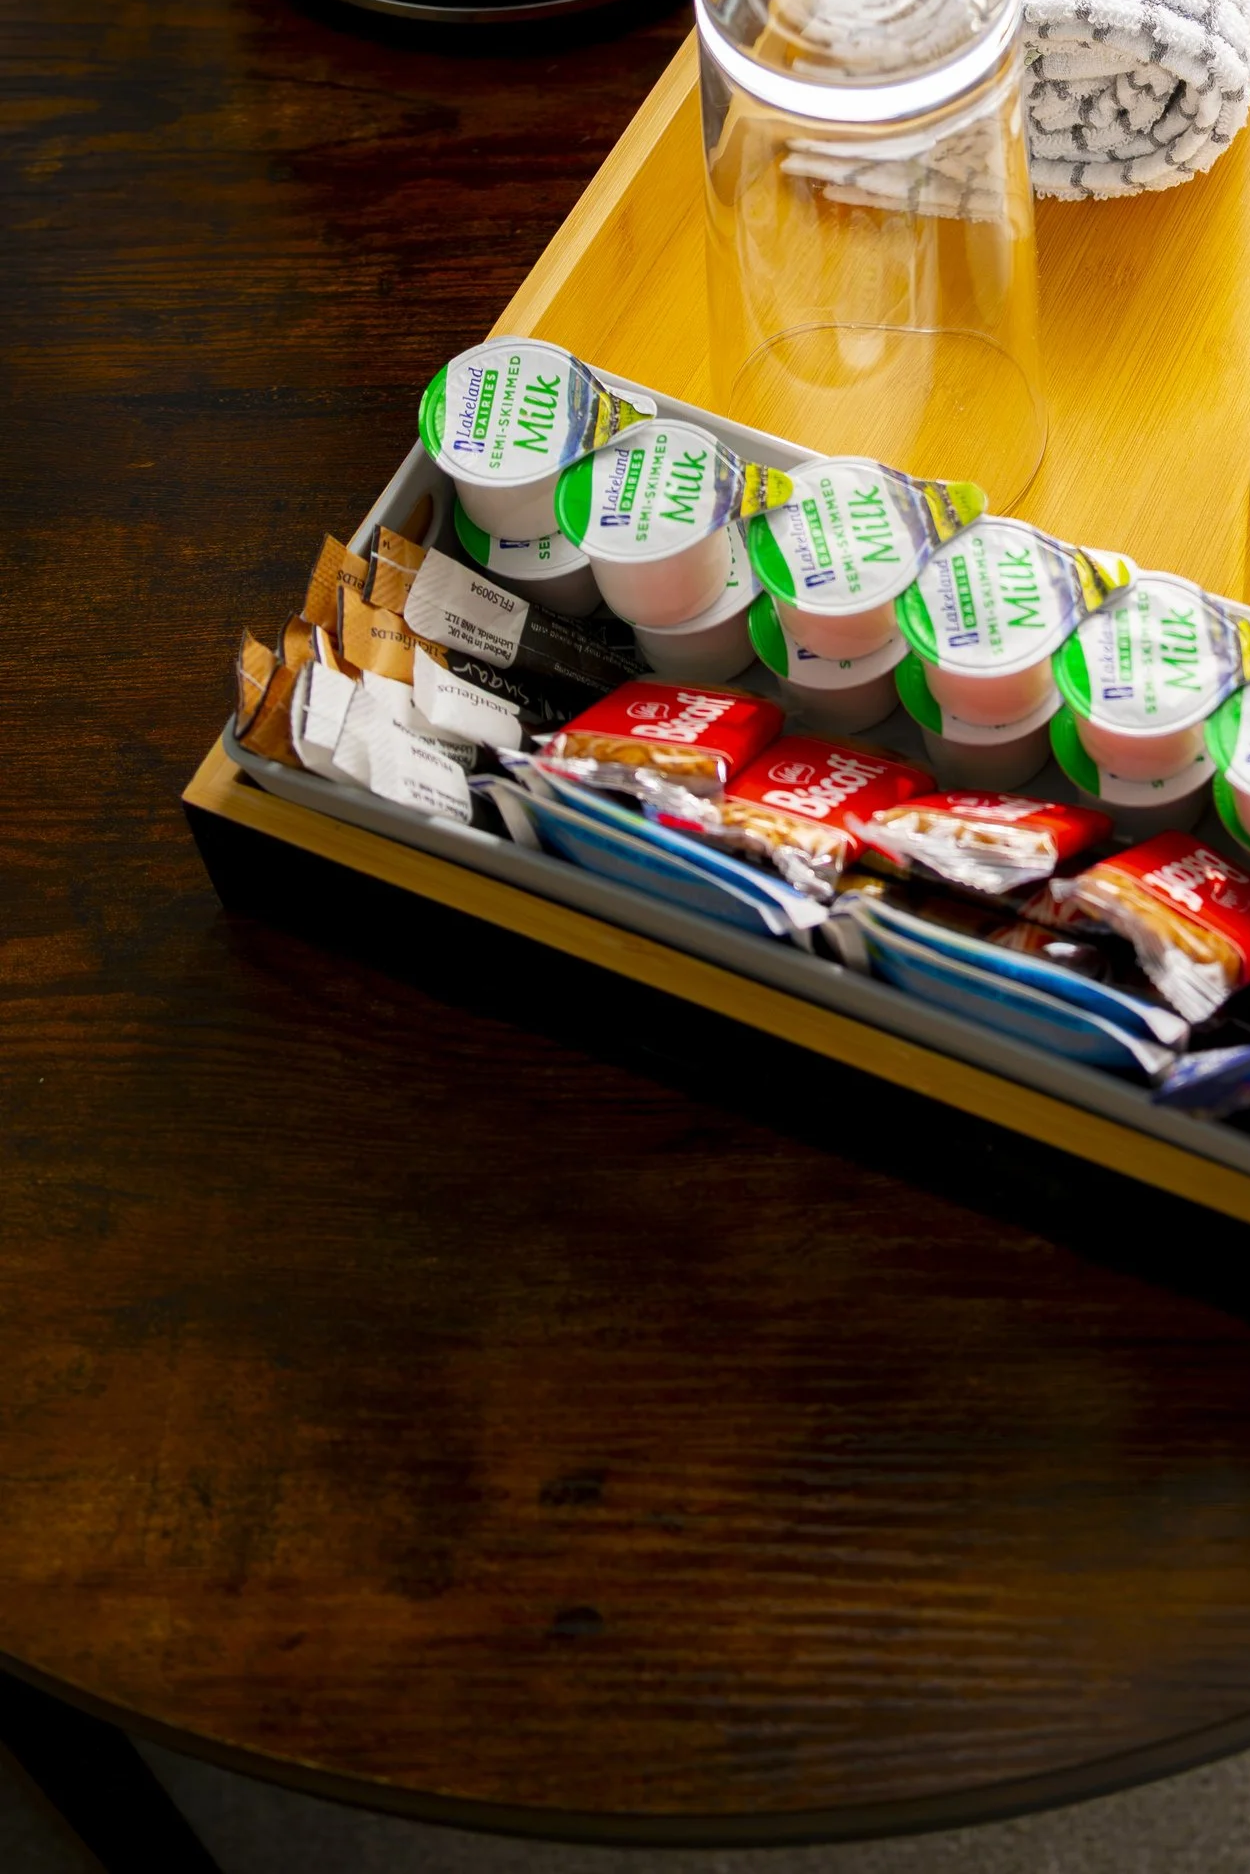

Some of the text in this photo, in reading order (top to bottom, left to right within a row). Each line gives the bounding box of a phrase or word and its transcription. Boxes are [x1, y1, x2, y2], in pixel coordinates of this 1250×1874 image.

[461, 367, 484, 437] Lakeland
[475, 372, 497, 438] DAIRIES
[489, 355, 521, 469] SEMI-SKIMMED
[513, 374, 561, 454] Milk
[603, 448, 629, 511] Lakeland
[621, 451, 644, 511] DAIRIES
[636, 434, 668, 542] SEMI-SKIMMED
[660, 450, 707, 524] Milk
[783, 504, 816, 571] Lakeland
[820, 477, 862, 594] SEMI-SKIMMED
[848, 485, 901, 564] Milk
[470, 581, 515, 613] FFLS0094
[933, 559, 960, 632] Lakeland
[972, 537, 1004, 657] SEMI-SKIMMED
[997, 547, 1046, 629] Milk
[461, 632, 473, 644] the
[474, 639, 483, 648] in
[483, 642, 512, 661] Packed
[1160, 607, 1202, 692] Milk
[631, 692, 736, 743] Biscoff
[762, 753, 884, 819] Biscoff
